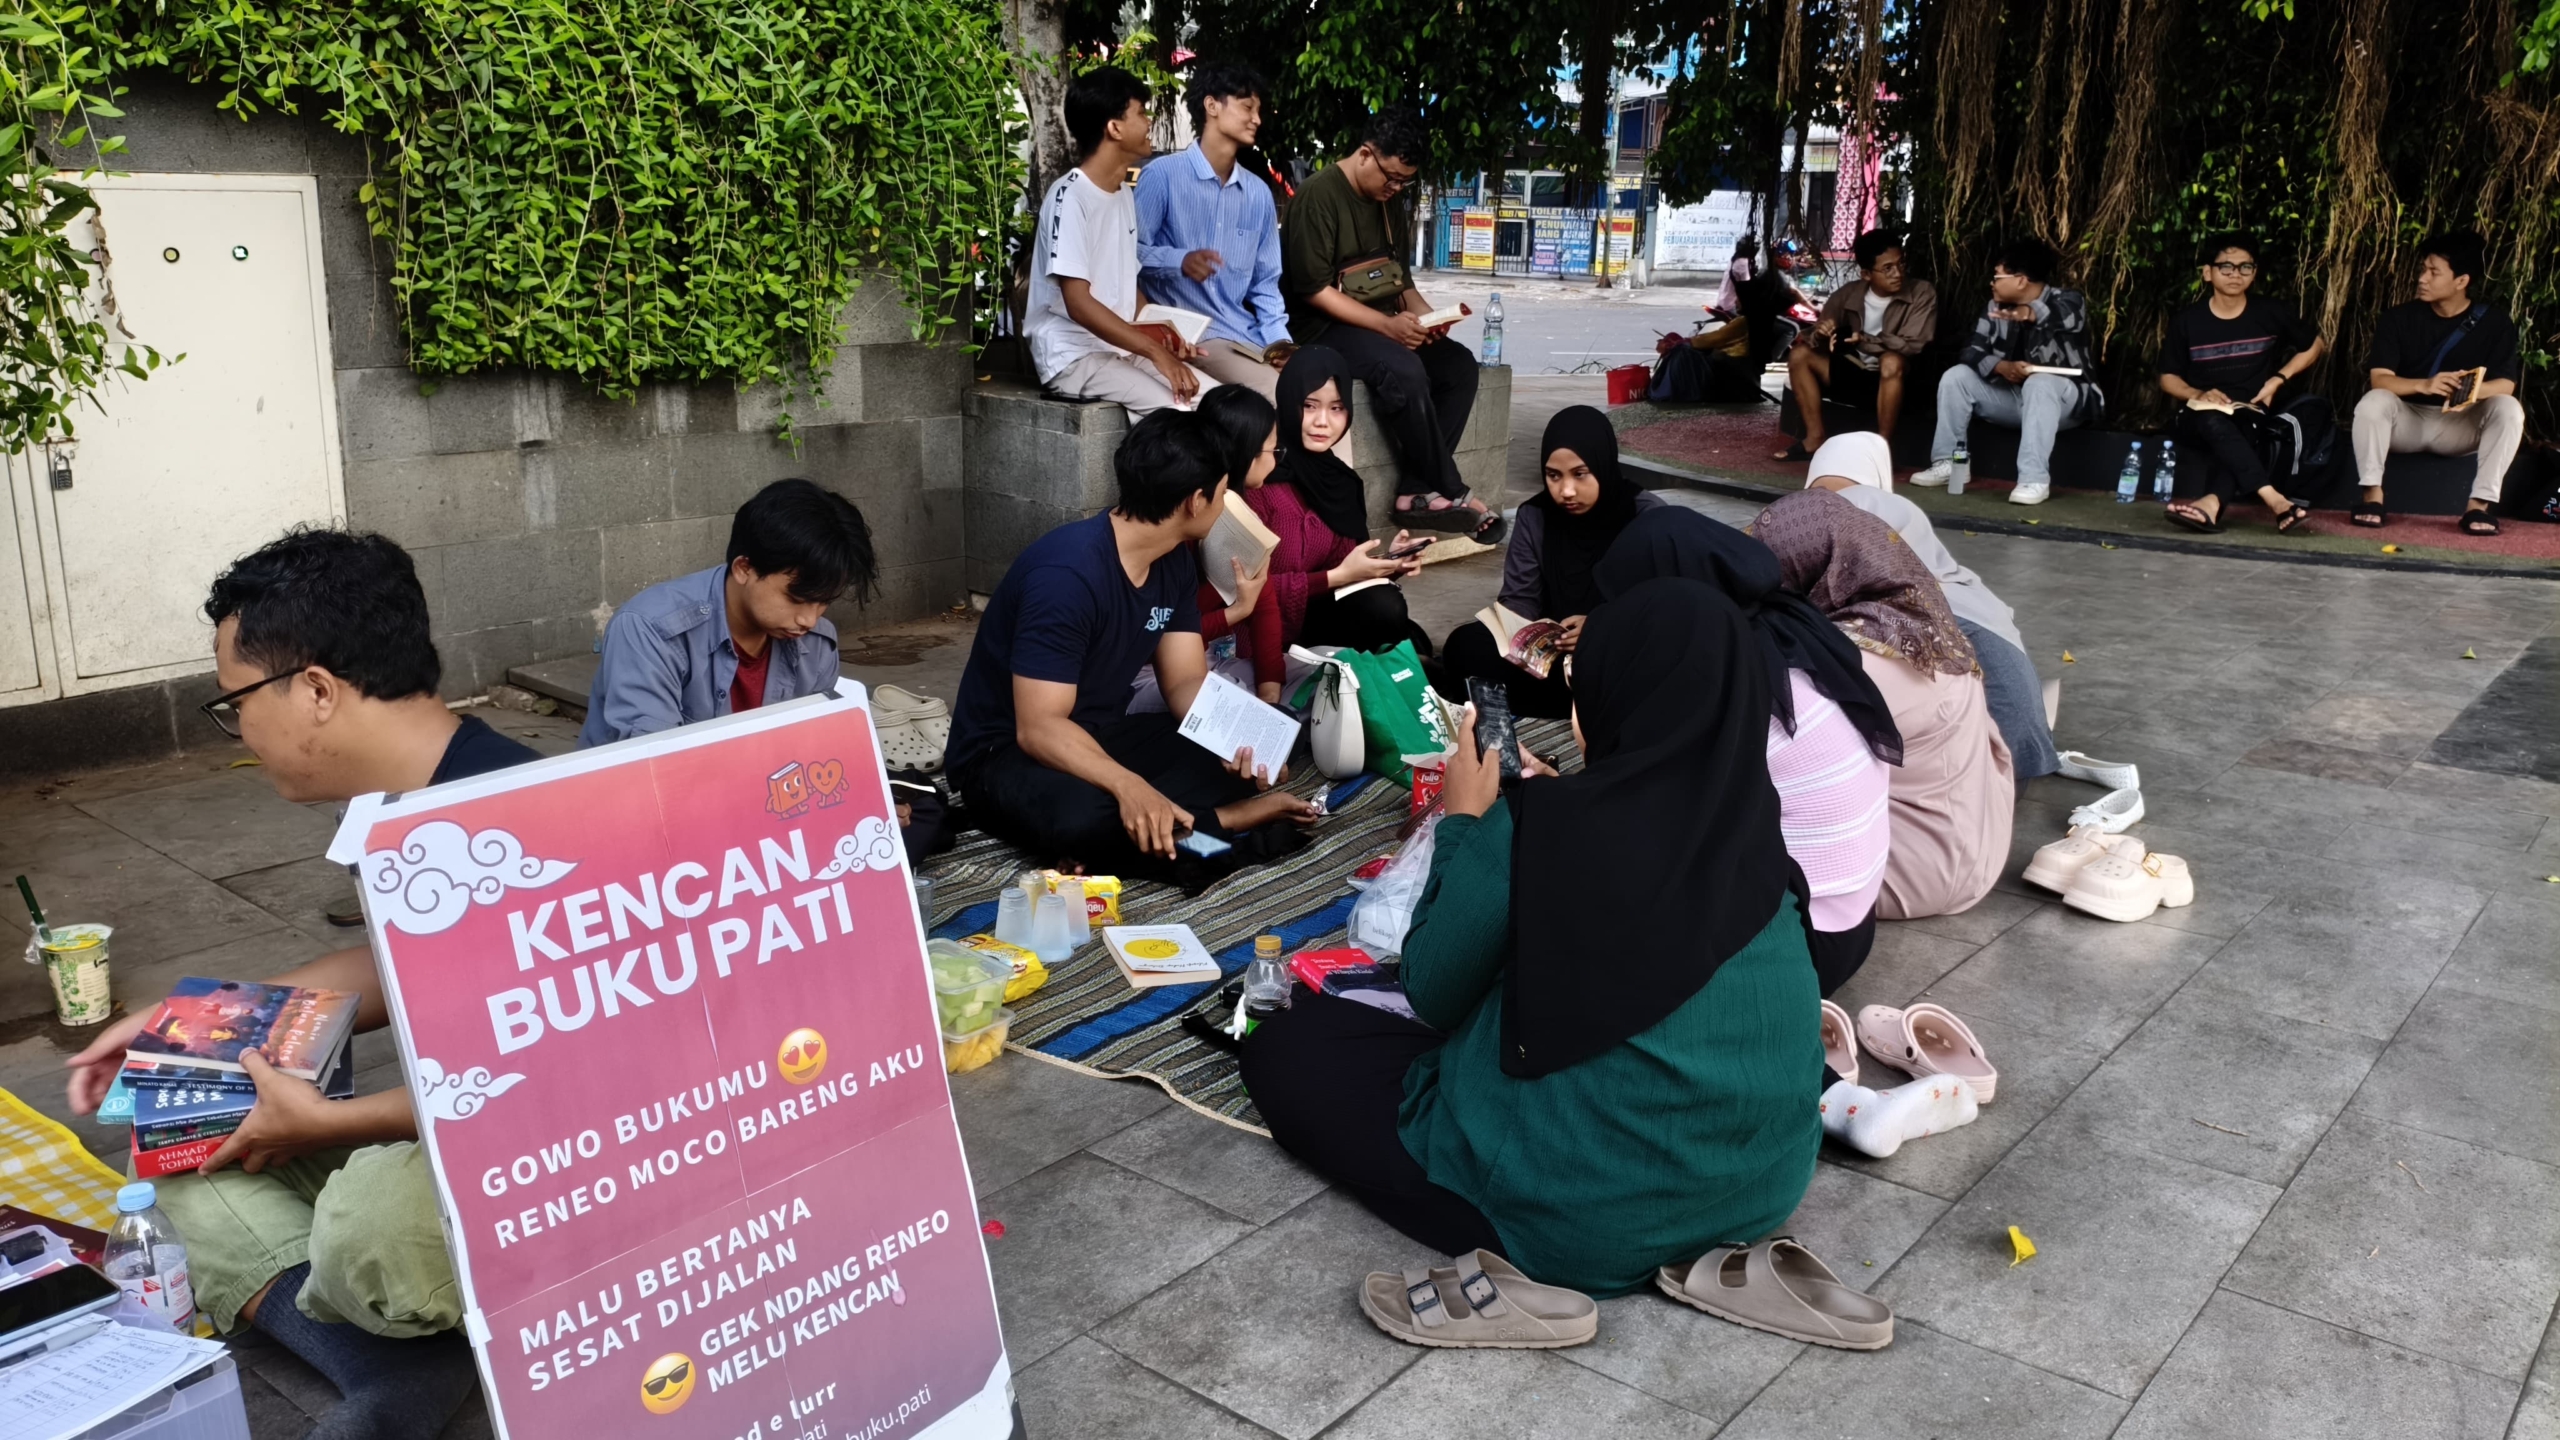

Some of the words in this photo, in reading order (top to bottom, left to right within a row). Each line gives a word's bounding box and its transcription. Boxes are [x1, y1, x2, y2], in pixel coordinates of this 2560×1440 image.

[486, 932, 698, 1055] BUKU
[708, 882, 854, 978] PATI
[507, 828, 811, 972] KENCAN
[157, 1145, 207, 1162] AHMAD
[158, 1155, 208, 1171] TOHARI
[481, 1129, 602, 1197] GOWO
[614, 1060, 769, 1145] BUKUMU
[494, 1177, 617, 1249] RENEO
[629, 1129, 727, 1190] MOCO
[737, 1072, 859, 1143] BARENG
[869, 1044, 925, 1088] AKU
[519, 1284, 623, 1355] MALU
[635, 1197, 812, 1298] BERTANYA
[528, 1313, 643, 1392] SESAT
[657, 1237, 798, 1328] DIJALAN
[699, 1311, 764, 1356] GEK
[764, 1256, 861, 1325] NDANG
[867, 1209, 951, 1271] RENEO
[706, 1332, 788, 1393] MELU
[795, 1269, 900, 1347] KENCAN
[770, 1415, 783, 1431] e
[789, 1382, 837, 1420] lurr
